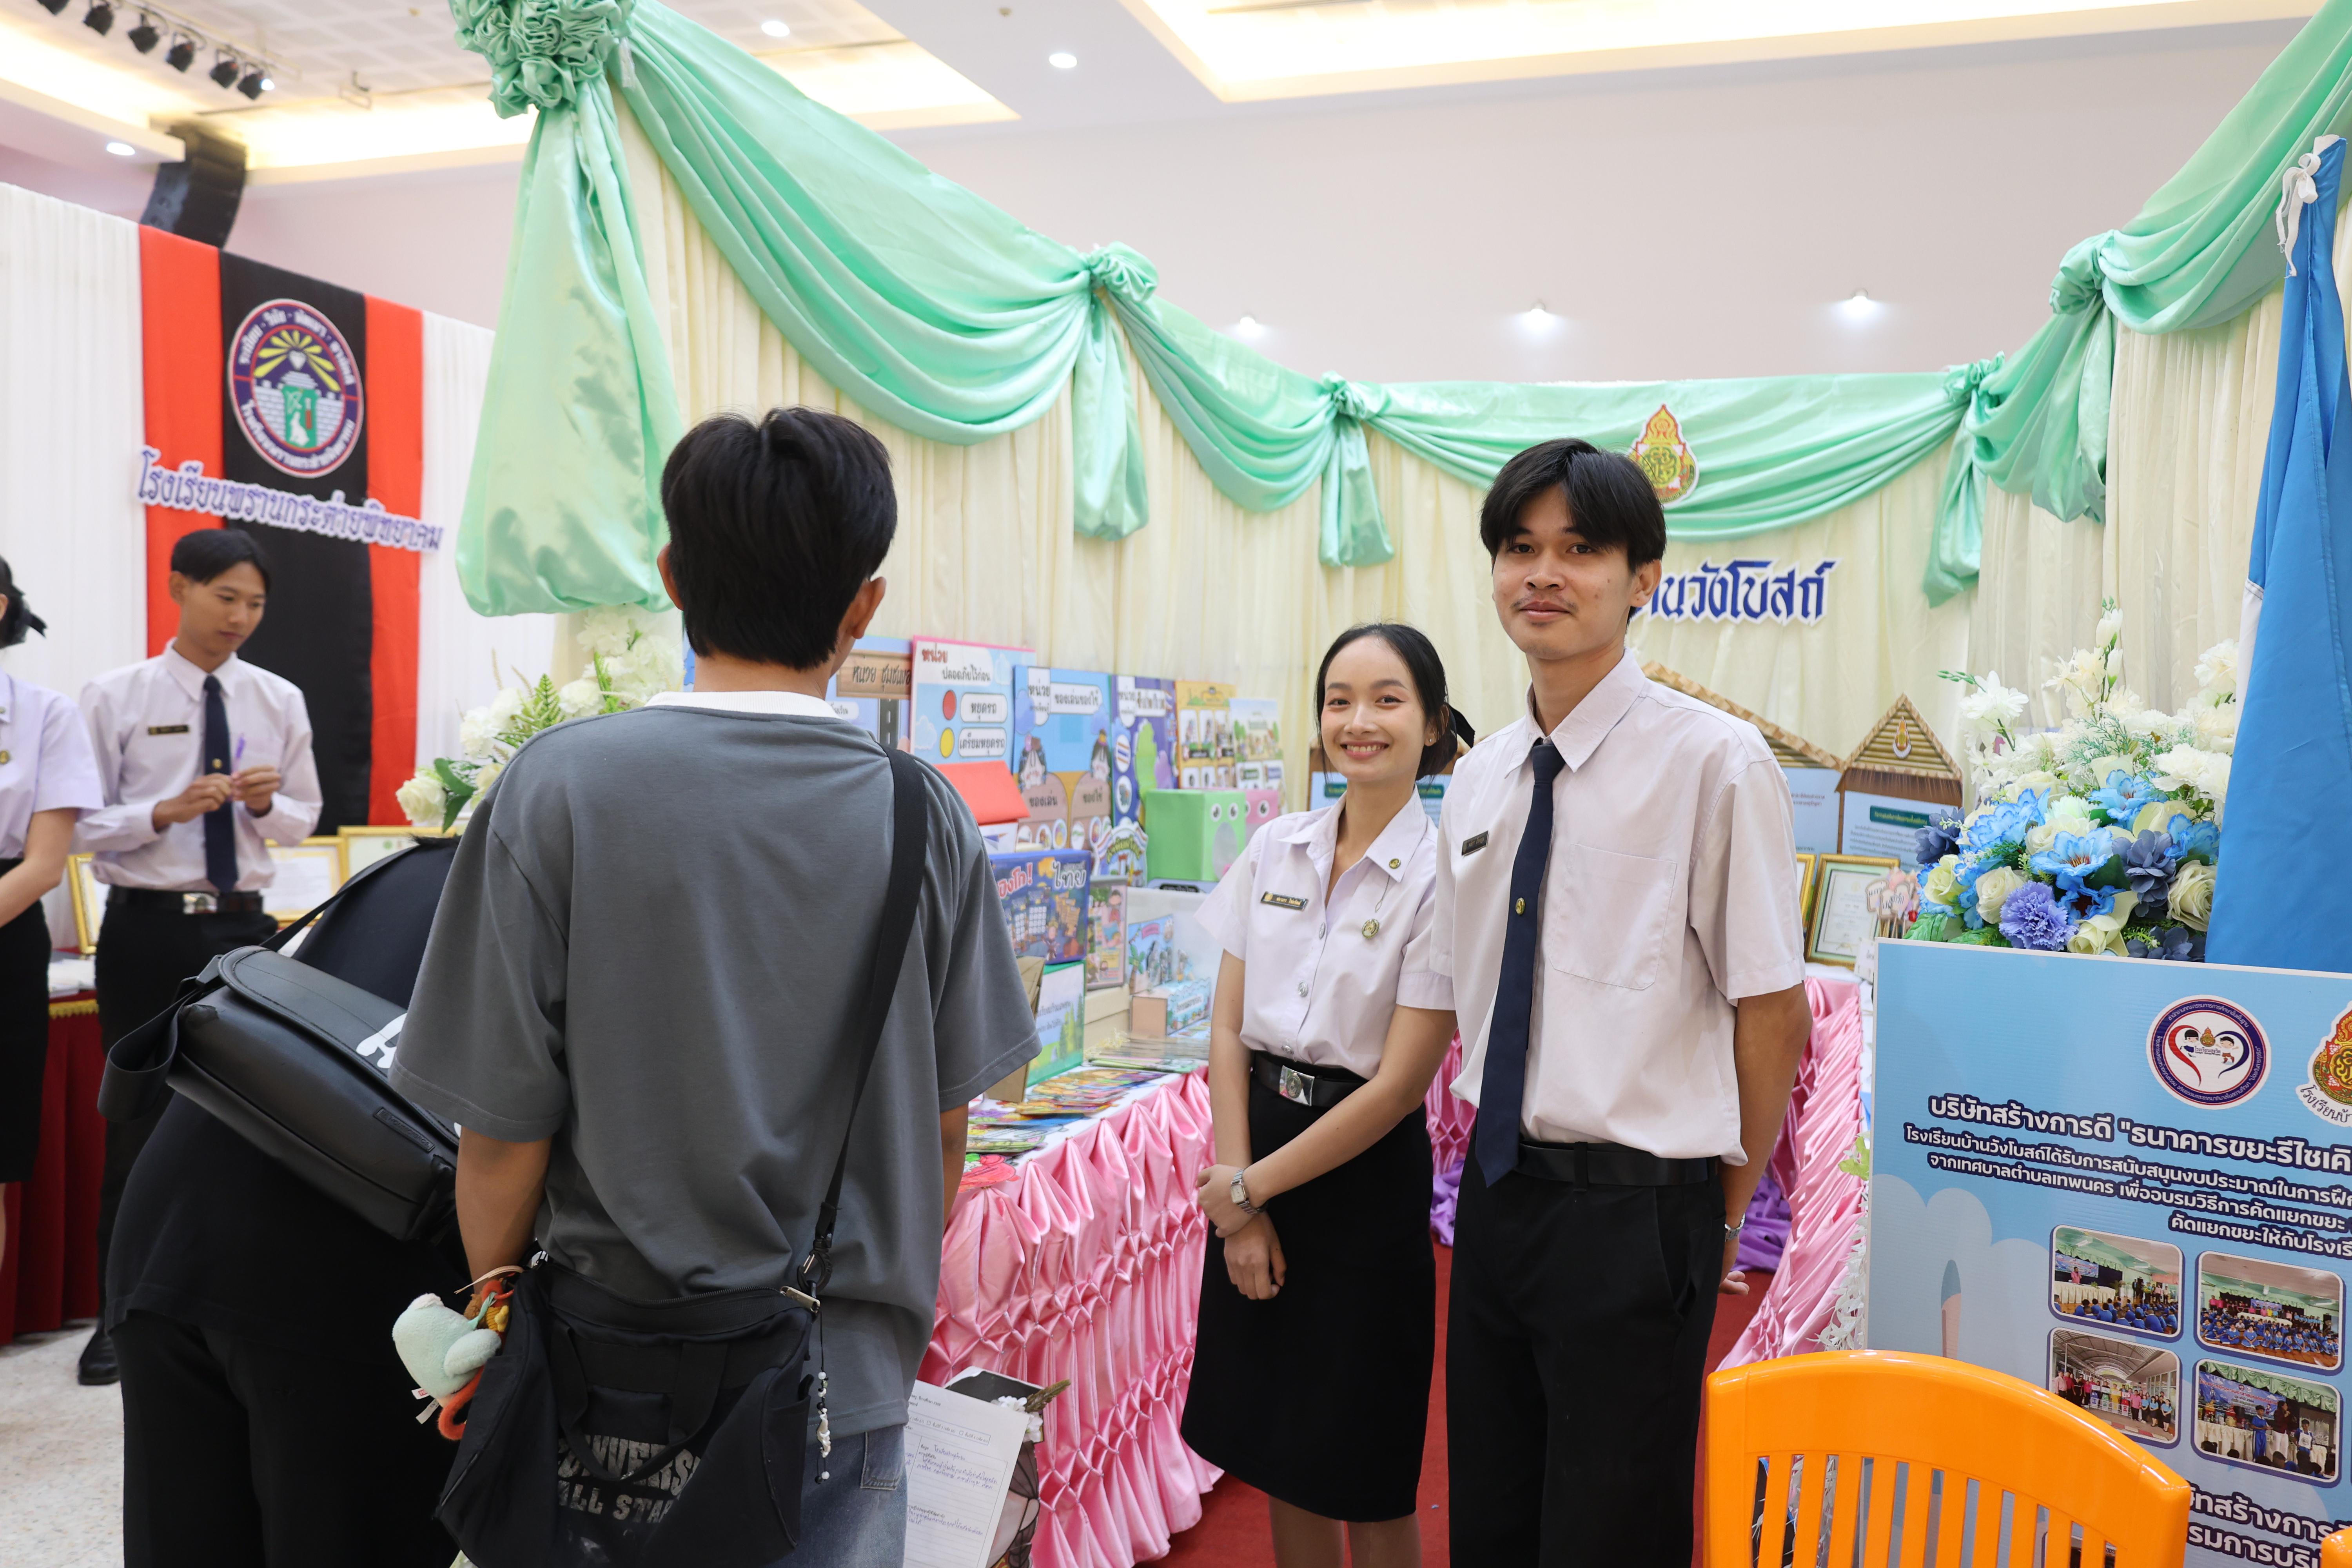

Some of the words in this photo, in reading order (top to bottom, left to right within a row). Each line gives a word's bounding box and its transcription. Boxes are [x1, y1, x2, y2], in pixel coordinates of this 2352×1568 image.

[138, 448, 445, 551] โรงเรียนพรานกระต่ายพิทยาคม
[1052, 861, 1087, 889] ไทย
[1930, 1096, 2112, 1139] บริษัทสร้างการดี
[1930, 1154, 2114, 1194] จากเทศบาลตำบลเทพนคร
[2120, 1179, 2345, 1230] เพื่ออบรมวิธีการคัดแยกขยะ
[2190, 1487, 2352, 1541] ทสร้างการ
